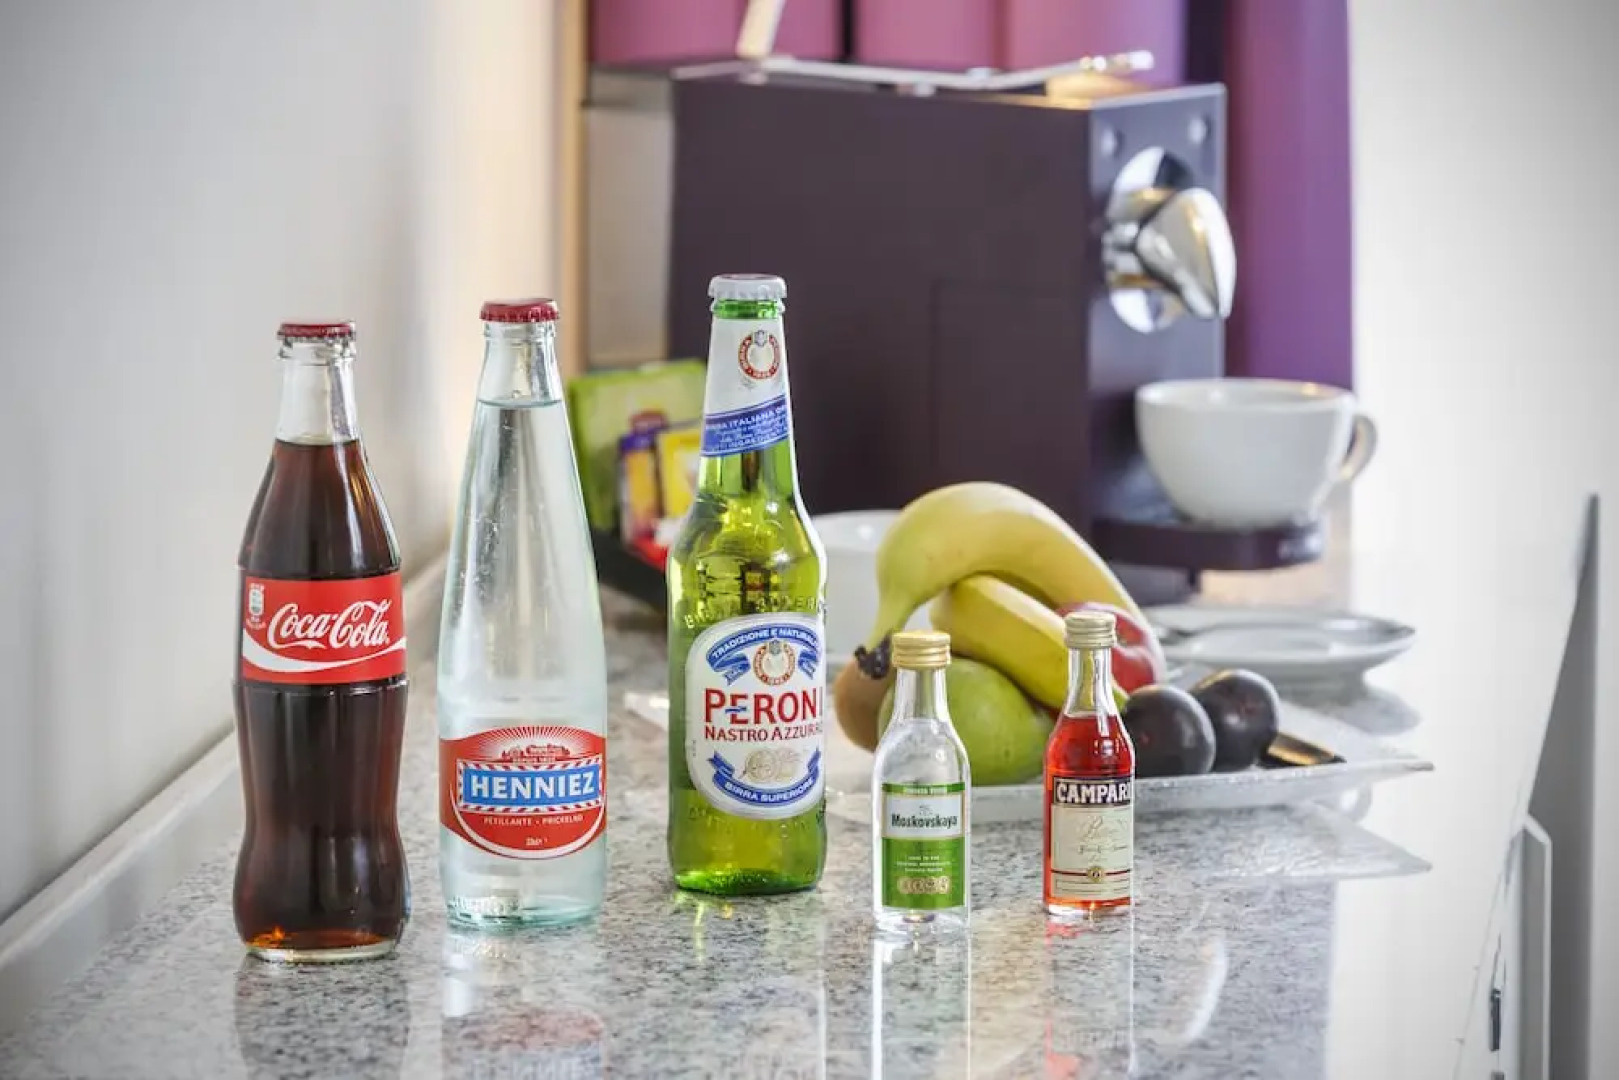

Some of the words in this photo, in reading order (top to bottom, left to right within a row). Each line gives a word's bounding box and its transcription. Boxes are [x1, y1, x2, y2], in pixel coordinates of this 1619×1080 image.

[267, 599, 391, 649] Coca-Cola
[712, 629, 770, 658] TRADIZIONE
[704, 726, 768, 741] NASTRO
[470, 771, 595, 799] HENNIEZ
[725, 781, 759, 801] BIRRA
[761, 777, 814, 802] SUPERIORE
[891, 813, 958, 829] Moskovskaya
